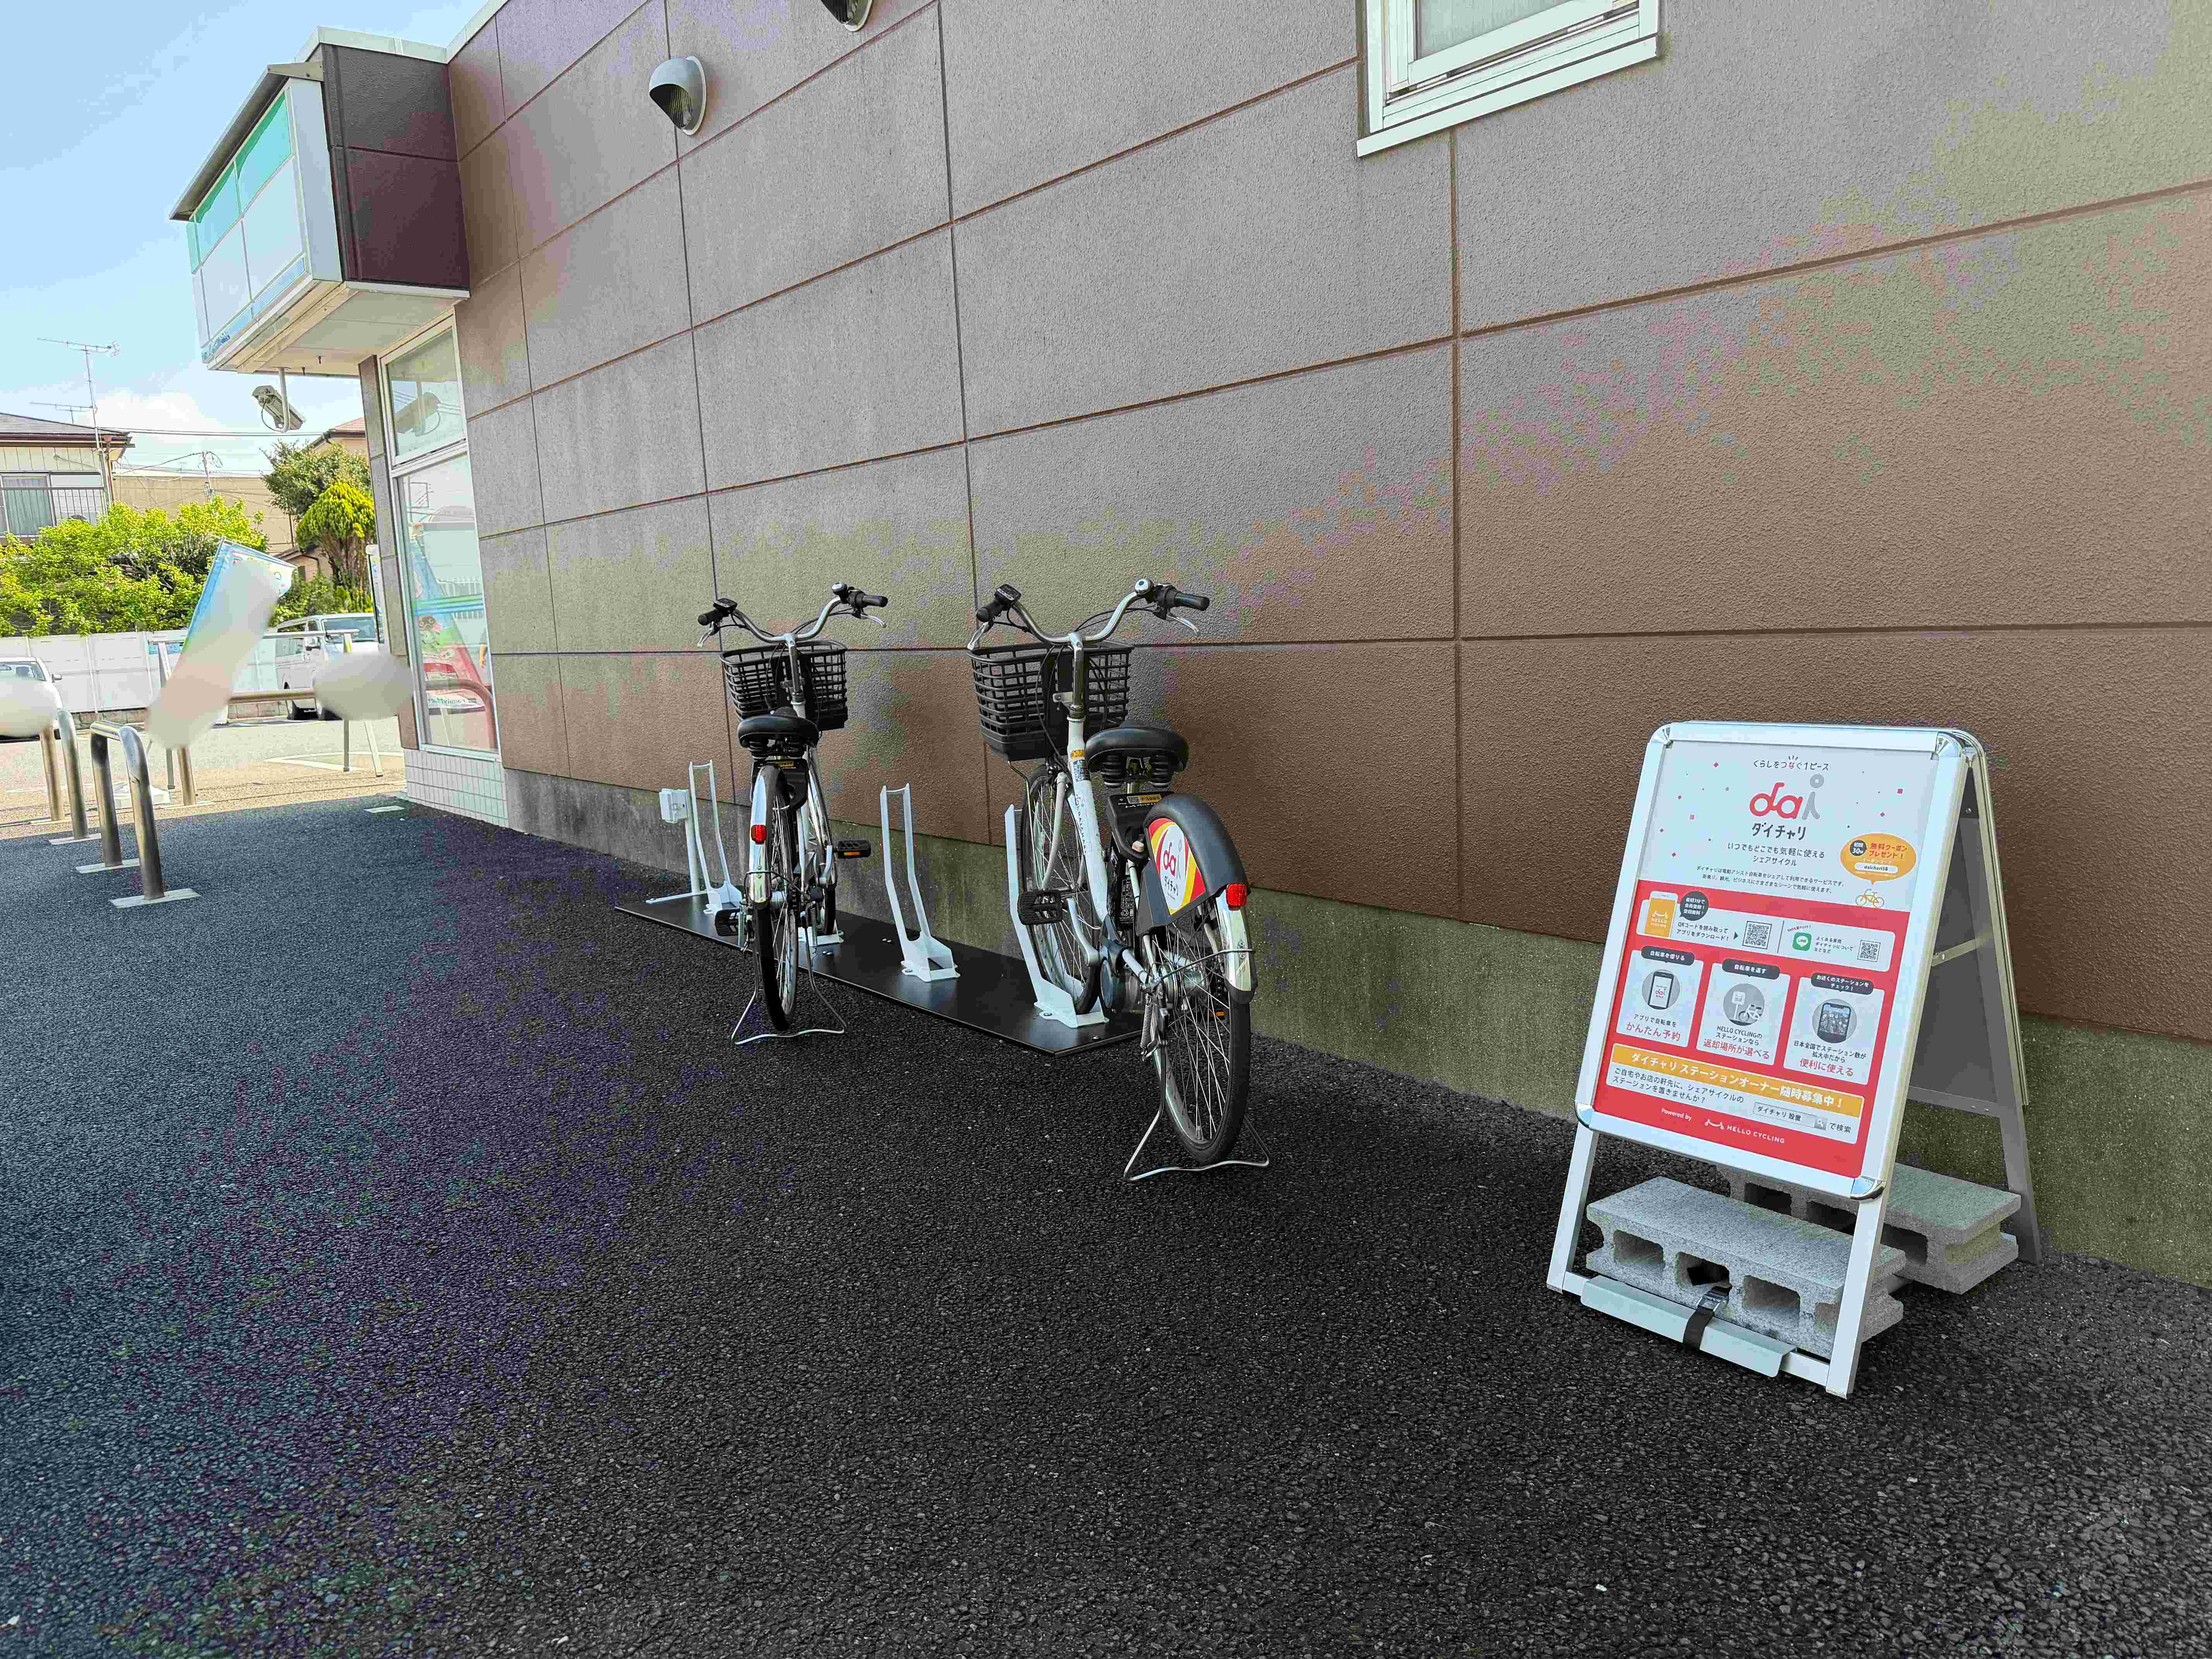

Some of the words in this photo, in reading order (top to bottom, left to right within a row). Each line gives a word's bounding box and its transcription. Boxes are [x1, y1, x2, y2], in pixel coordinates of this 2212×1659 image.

[1749, 774, 1824, 820] dai
[1752, 822, 1806, 840] ダイチャリ
[1727, 843, 1825, 859] いつでもどこでも気軽に使える
[1870, 842, 1907, 852] 無料クーポン
[1753, 855, 1797, 866] シェアサイクル
[1677, 922, 1729, 934] QRコードを読み取って
[1676, 929, 1729, 942] アプリをダウンロード！
[1815, 942, 1854, 951] ダイチャリについて
[1650, 950, 1685, 961] 自転車を借りる
[1734, 964, 1767, 974] 自転車を返す
[1816, 975, 1869, 988] お近くのステーションを
[1830, 983, 1853, 991] チェック！
[1633, 1013, 1676, 1027] アプリで自転車を
[1626, 1022, 1681, 1041] かんたん予約
[1716, 1025, 1734, 1034] HELLO
[1734, 1029, 1762, 1039] CYCLINGの
[1716, 1032, 1759, 1046] ステーションなら
[1704, 1038, 1770, 1060] 返却場所が選べる
[1793, 1040, 1867, 1060] 日本全国でステーション数が
[1631, 1053, 1678, 1072] ダイチャリ
[1812, 1051, 1846, 1063] 拡大中だから
[1800, 1058, 1853, 1077] 便利に使える
[1612, 1076, 1706, 1103] ステーションを置きませんか？
[1661, 1107, 1684, 1119] Powered
[1685, 1113, 1692, 1121] by
[1756, 1105, 1787, 1118] ダイチャリ
[1788, 1112, 1802, 1122] 設置
[1727, 1124, 1751, 1135] HELLO
[1753, 1131, 1785, 1144] CYCLING
[1829, 1122, 1852, 1134] で検索
